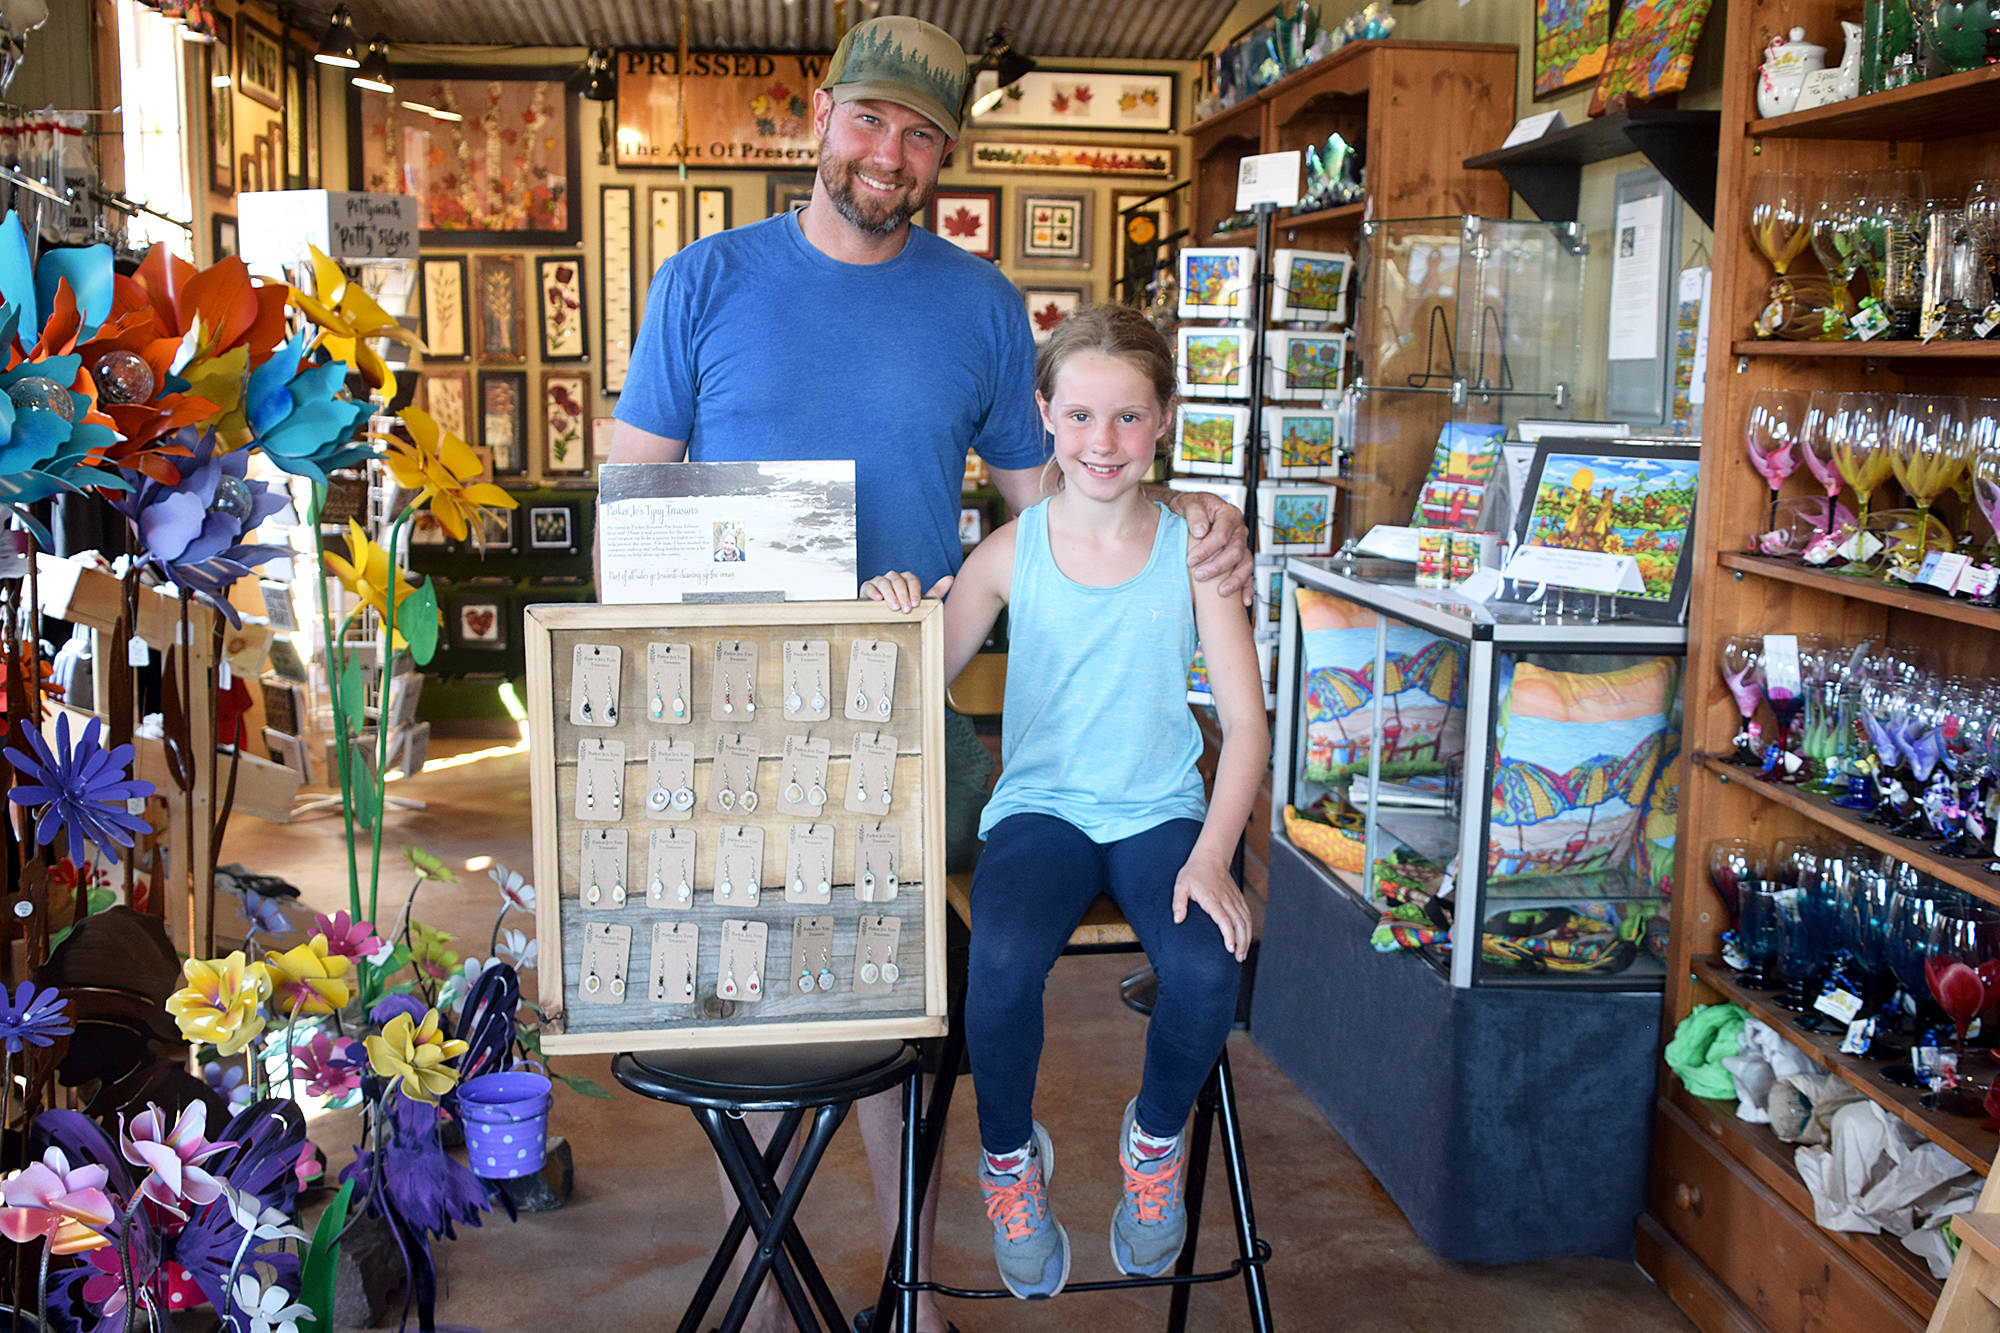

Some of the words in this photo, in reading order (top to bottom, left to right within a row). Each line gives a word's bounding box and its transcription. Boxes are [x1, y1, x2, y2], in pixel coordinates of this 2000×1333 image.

[797, 56, 827, 78] W
[623, 141, 660, 156] The
[668, 142, 701, 158] Art
[710, 142, 735, 158] Of
[741, 143, 820, 160] Preserv
[607, 503, 629, 516] Parker
